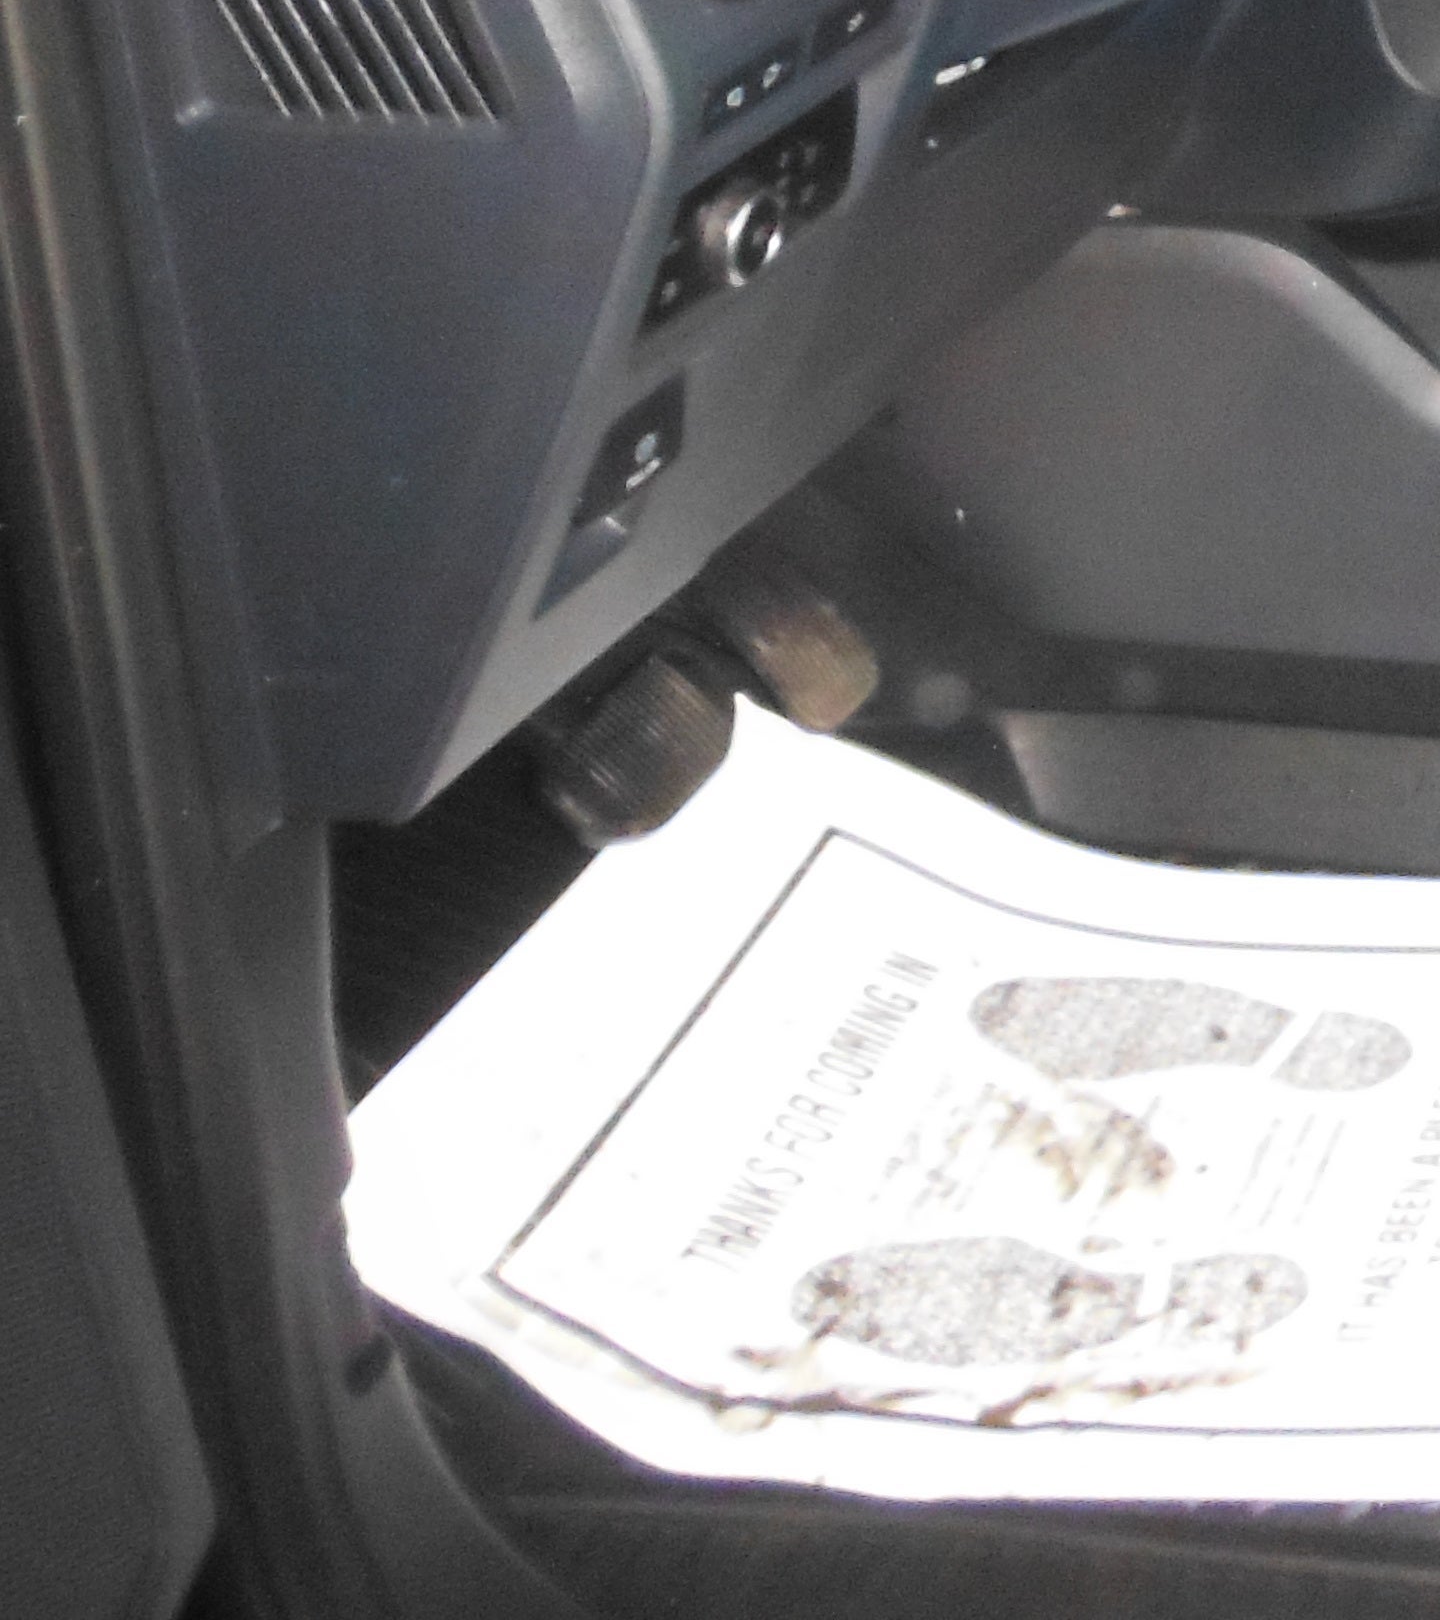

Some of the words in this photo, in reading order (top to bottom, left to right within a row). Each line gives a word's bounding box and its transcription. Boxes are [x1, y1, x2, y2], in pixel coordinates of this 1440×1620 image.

[681, 1156, 804, 1273] THANKS
[764, 1094, 847, 1162] FOR
[806, 983, 918, 1096] COMING
[879, 950, 939, 988] IN
[1378, 1178, 1435, 1242] BEEN
[1354, 1256, 1406, 1308] HAS
[1336, 1321, 1375, 1342] IT
